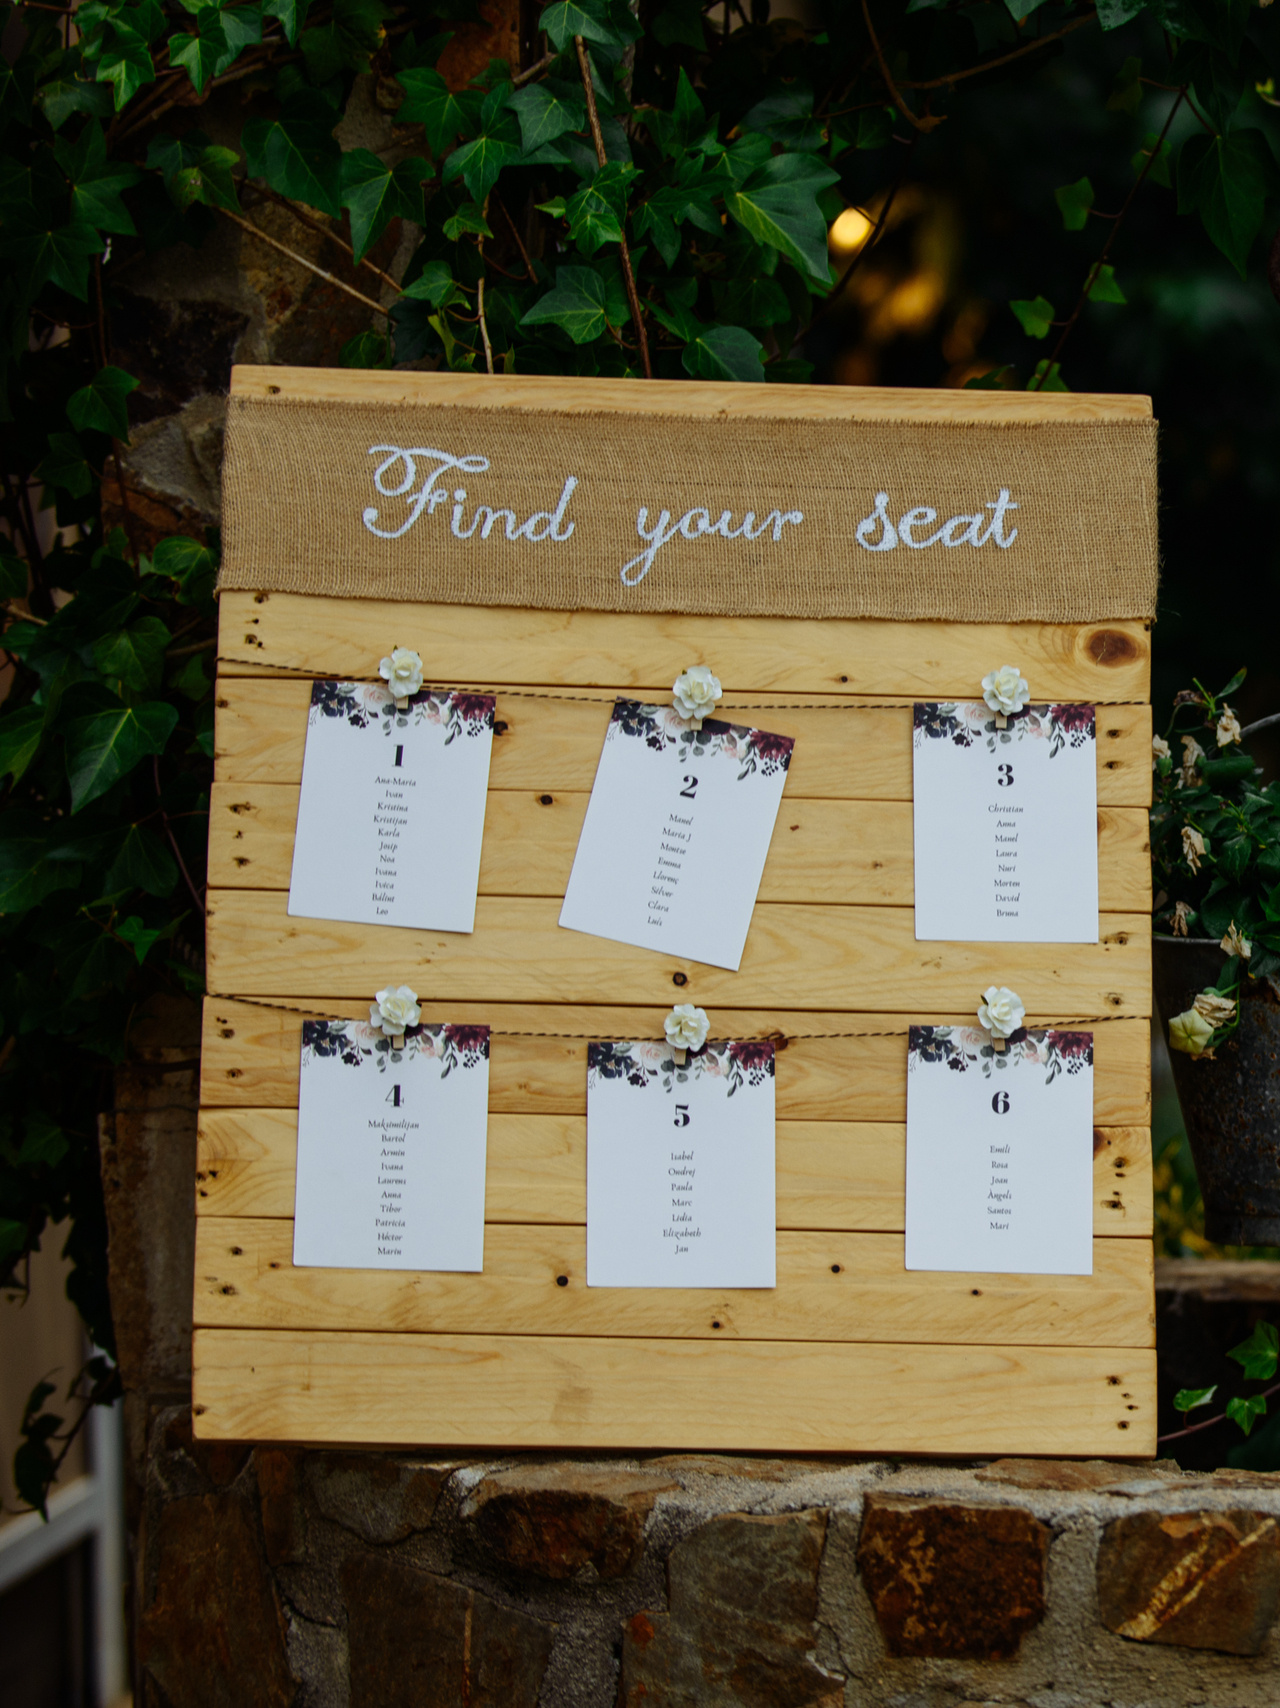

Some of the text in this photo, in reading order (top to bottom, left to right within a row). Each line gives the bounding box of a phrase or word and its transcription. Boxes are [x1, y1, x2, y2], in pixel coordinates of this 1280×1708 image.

[363, 445, 1019, 586] Find your seat
[392, 744, 404, 767] 1
[997, 763, 1014, 787] 3
[679, 775, 698, 799] 2
[386, 790, 403, 798] Ivan
[378, 802, 408, 812] Kristina
[988, 803, 1023, 812] Christian
[374, 815, 407, 827] Kristijan
[669, 814, 693, 825] Manel
[378, 828, 400, 837] Karla
[686, 833, 691, 842] J
[995, 833, 1018, 842] Manel
[379, 841, 397, 853] Josip
[660, 842, 686, 855] Montse
[380, 855, 395, 863] Noa
[658, 857, 681, 869] Emma
[376, 867, 397, 876] Ivana
[376, 880, 394, 889] Ivica
[994, 879, 1020, 887] Morten
[996, 893, 1020, 902] David
[376, 907, 388, 915] Leo
[648, 901, 669, 912] Clara
[997, 909, 1018, 917] Bruna
[385, 1084, 404, 1108] 4
[992, 1091, 1010, 1114] 6
[674, 1104, 690, 1127] 5
[381, 1133, 406, 1142] Bartol
[990, 1144, 1010, 1153] Emili
[671, 1151, 694, 1160] Isabel
[382, 1162, 403, 1170] Ivana
[668, 1166, 695, 1178] Ondrej
[991, 1176, 1008, 1185] Joan
[671, 1181, 692, 1191] Paula
[380, 1203, 402, 1213] Tibor
[376, 1219, 405, 1227] Patricia
[663, 1227, 701, 1240] Elizabeth
[675, 1245, 688, 1254] Jan
